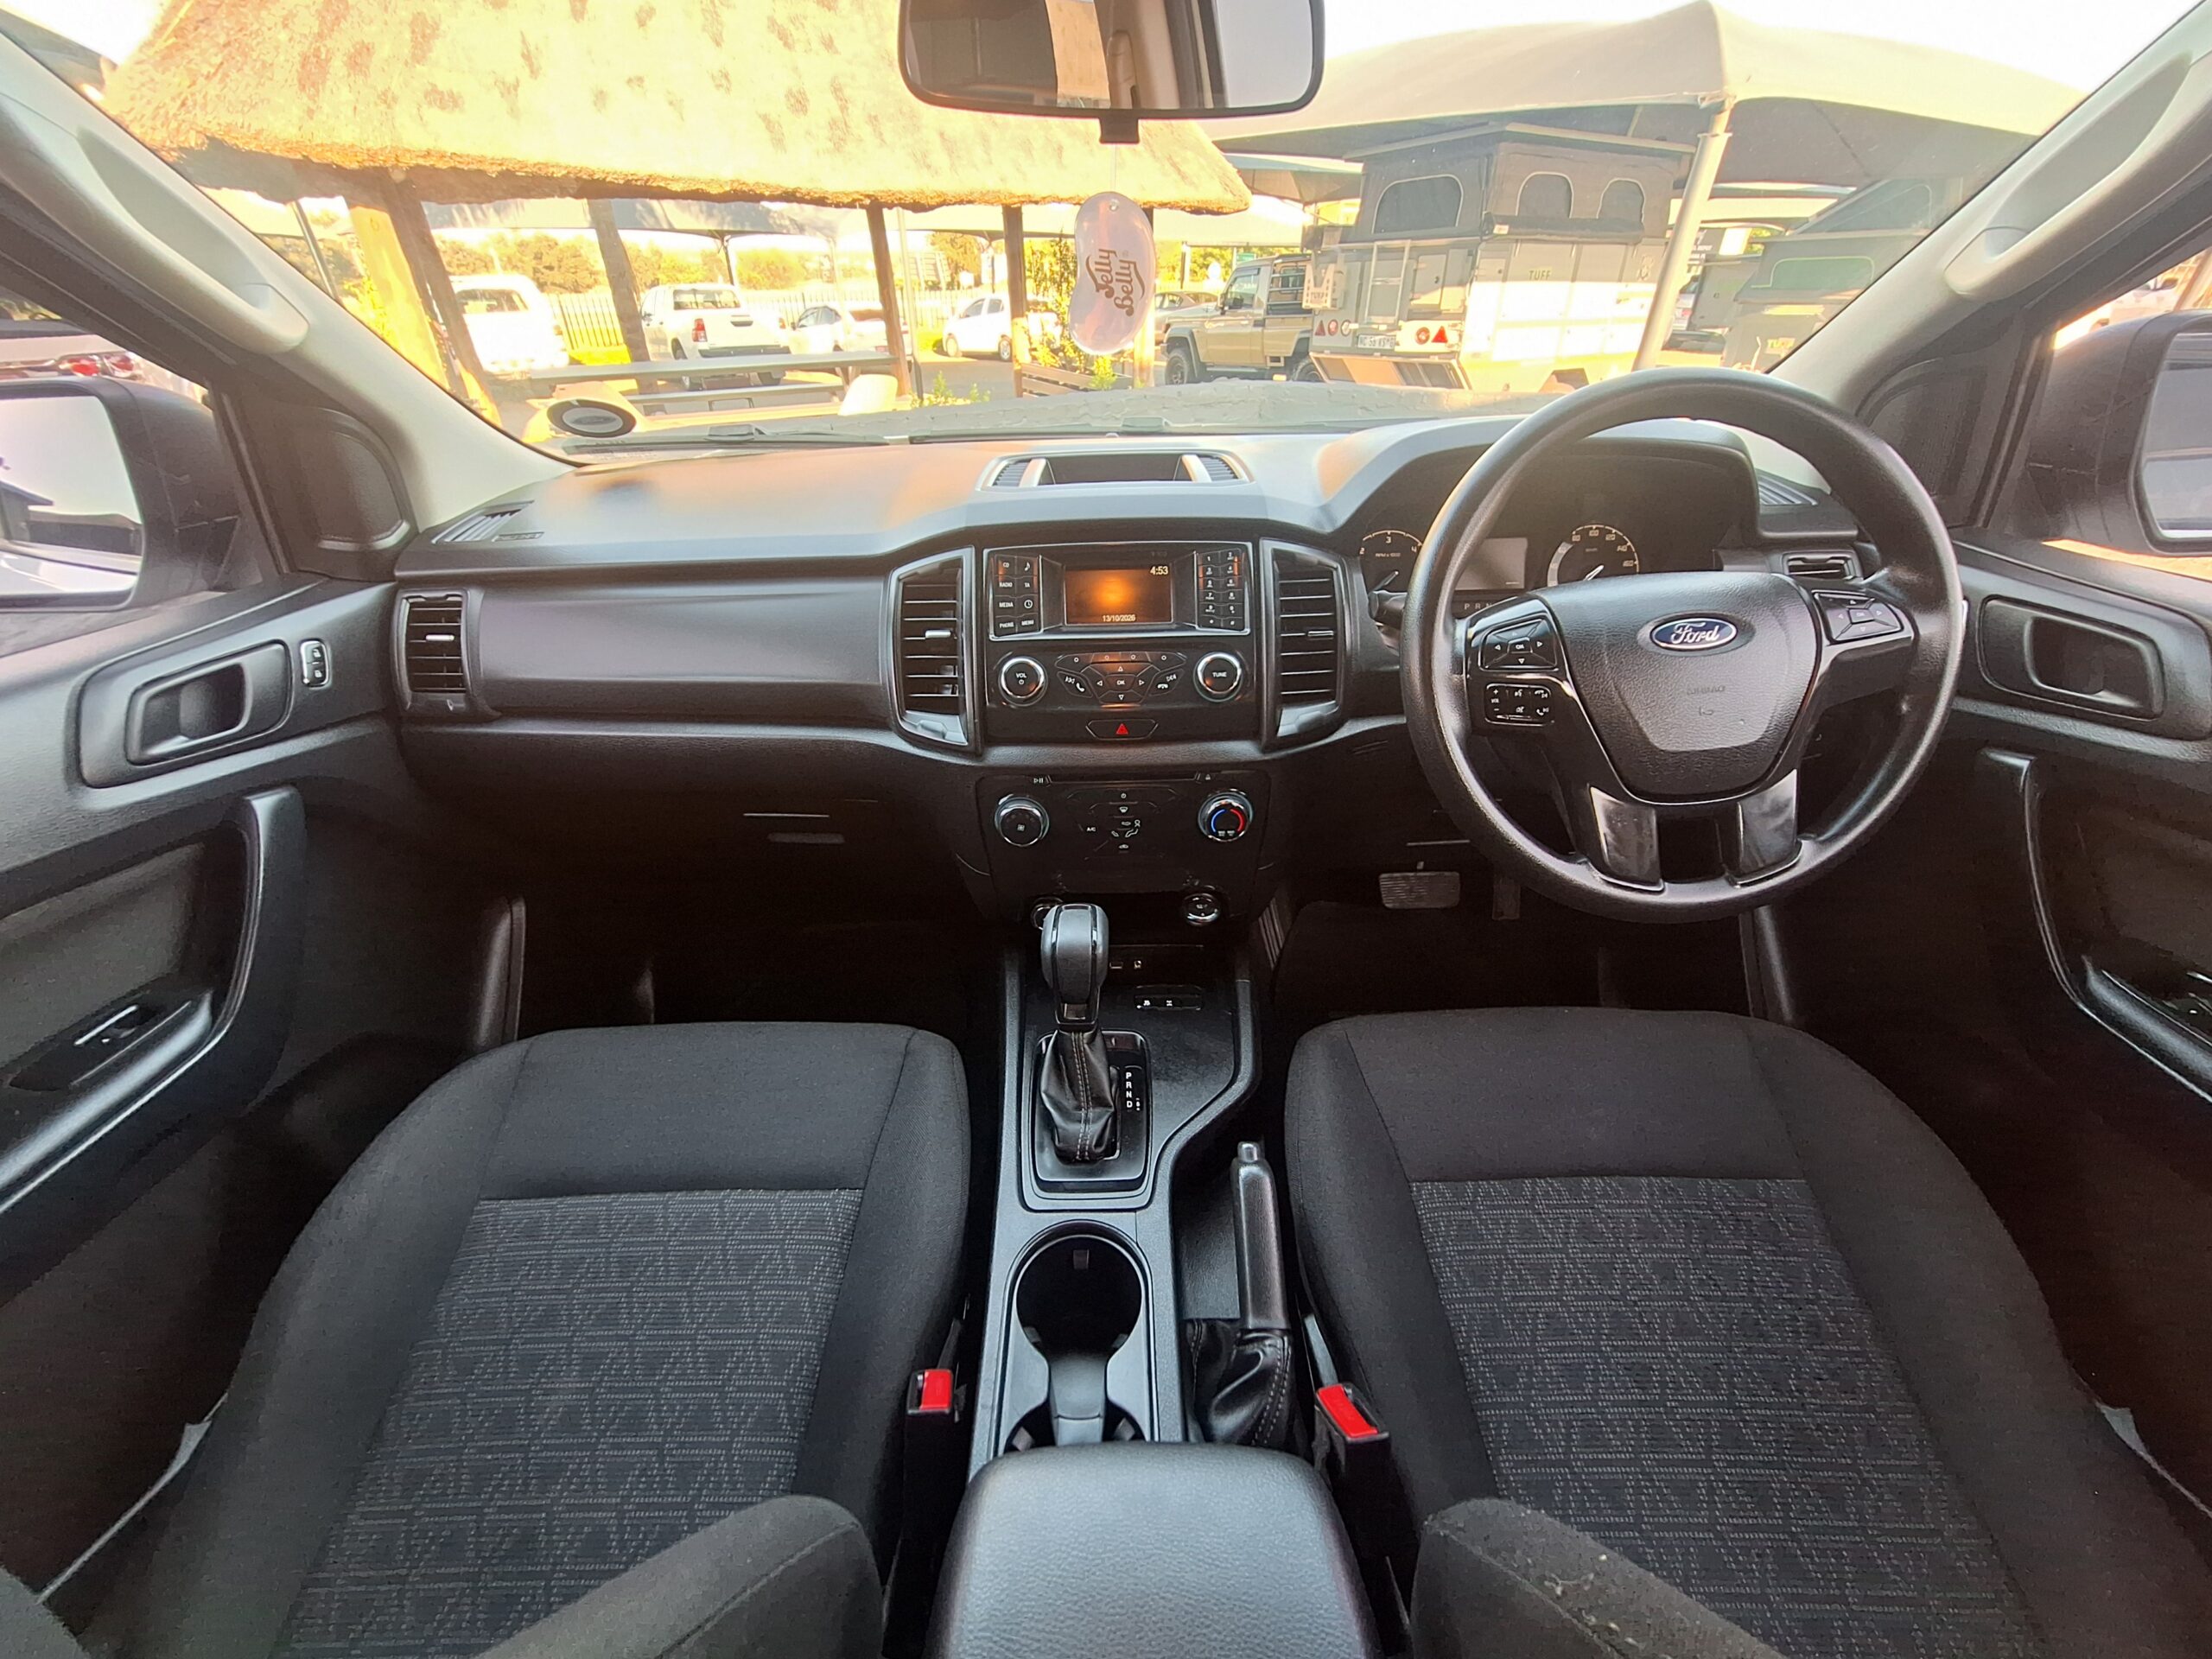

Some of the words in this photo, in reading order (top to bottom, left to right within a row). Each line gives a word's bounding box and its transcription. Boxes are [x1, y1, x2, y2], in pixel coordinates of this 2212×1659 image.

[1085, 249, 1117, 298] Jelly
[1529, 270, 1551, 281] TUFF
[1114, 259, 1145, 316] Belly
[1149, 565, 1169, 575] 4:53
[1670, 621, 1720, 645] Ford
[1126, 1100, 1133, 1109] D
